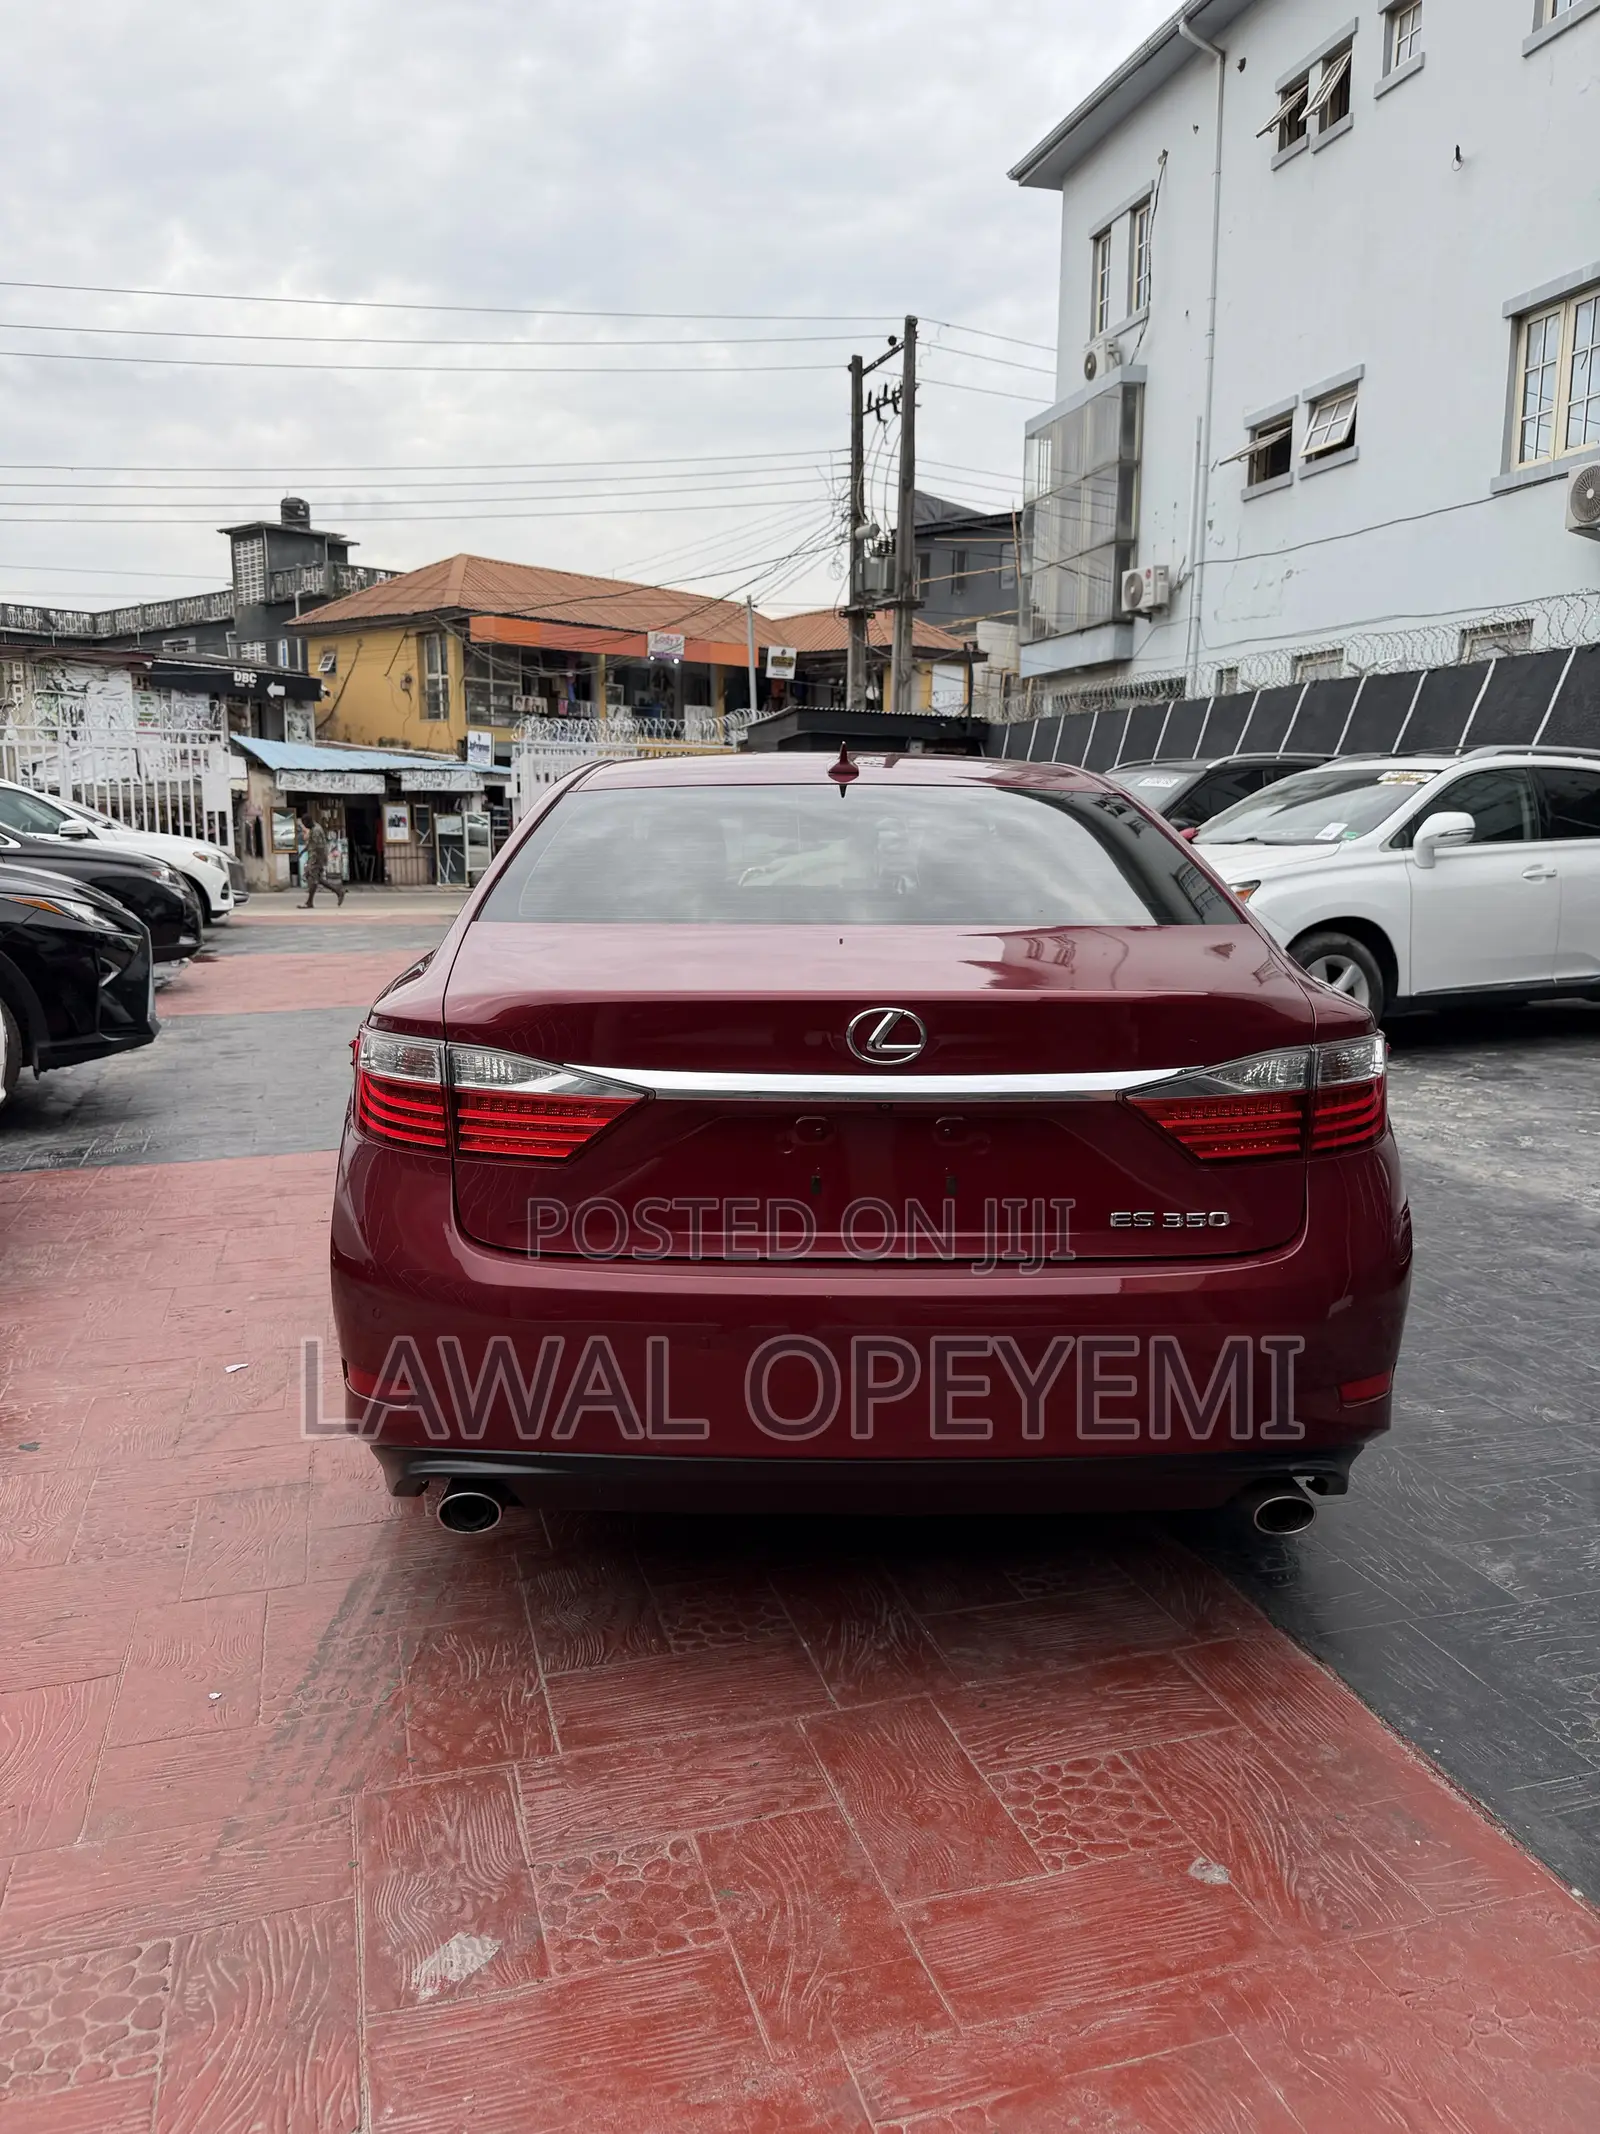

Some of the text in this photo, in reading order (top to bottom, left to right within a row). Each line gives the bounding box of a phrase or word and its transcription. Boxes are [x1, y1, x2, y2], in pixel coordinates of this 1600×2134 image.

[233, 670, 258, 684] DBC
[1110, 1211, 1230, 1228] ES 350
